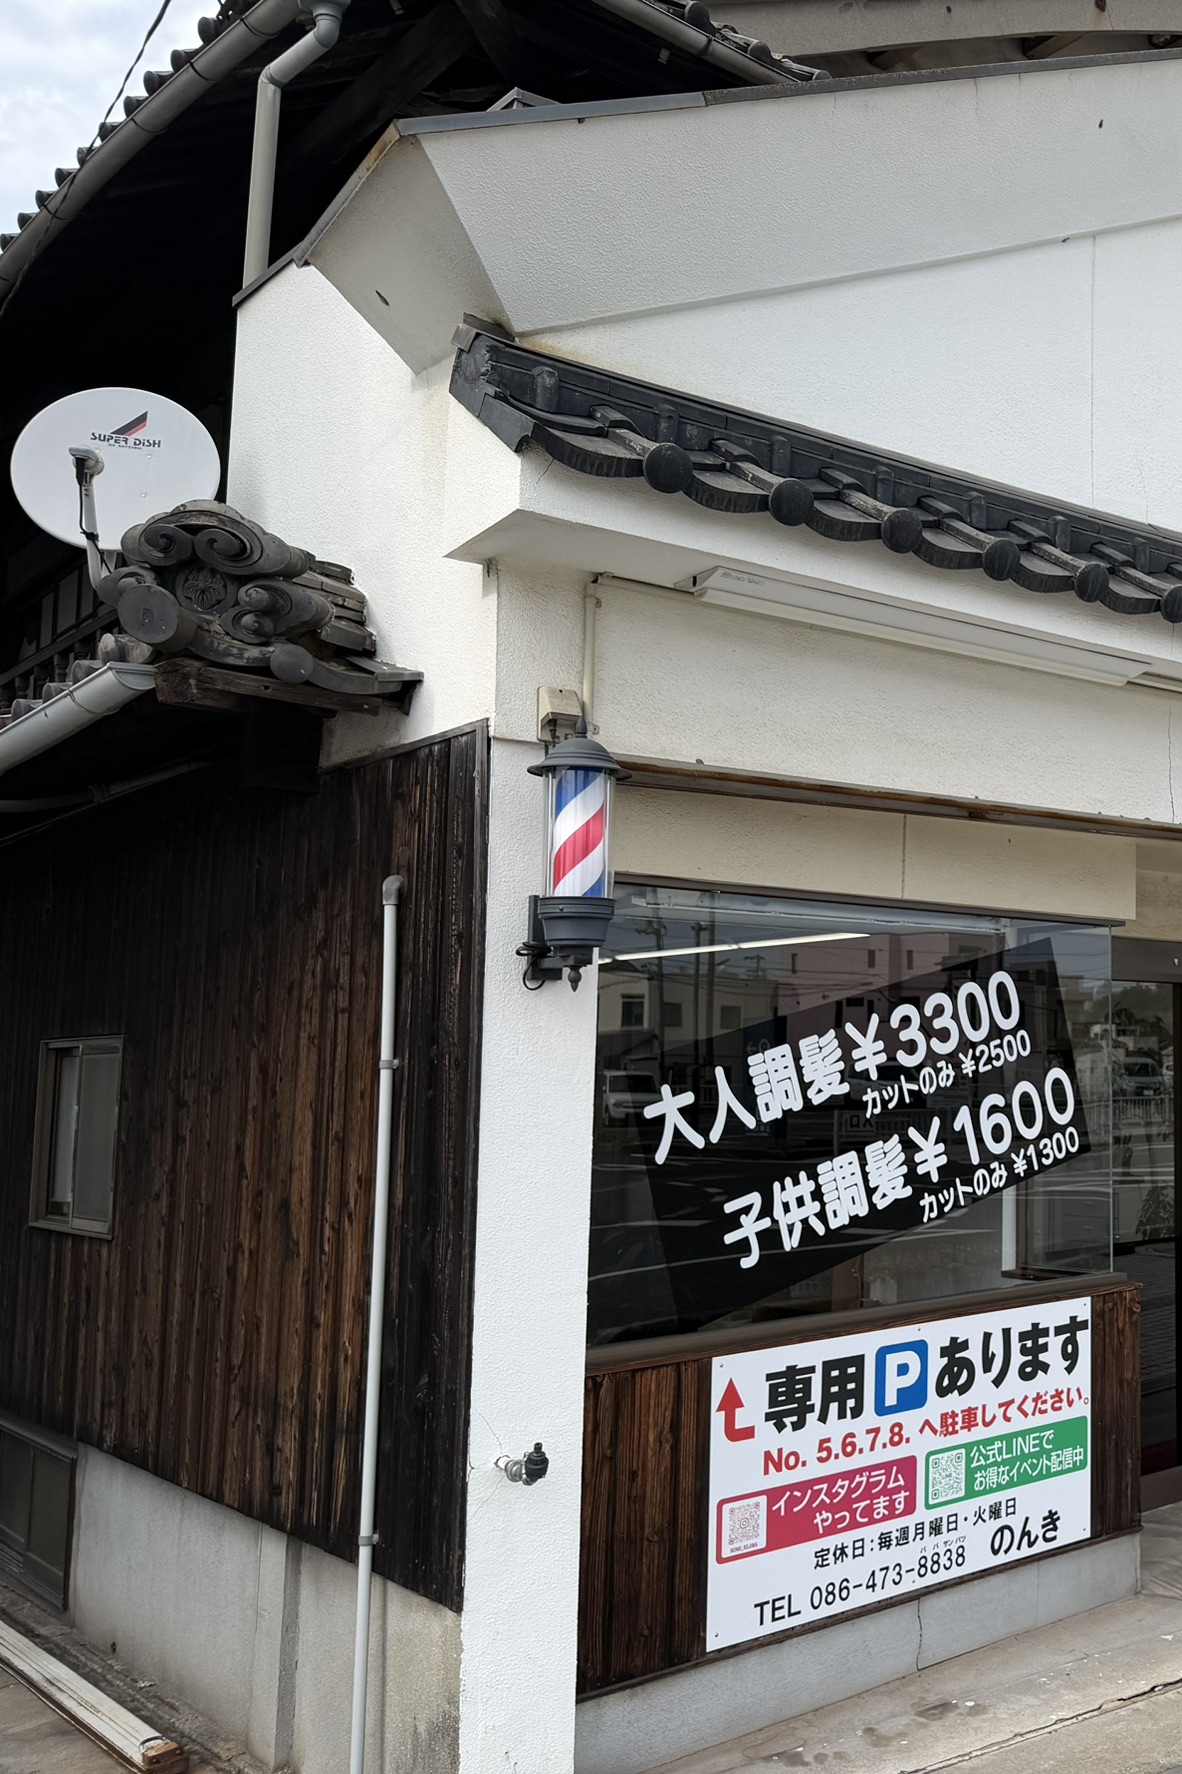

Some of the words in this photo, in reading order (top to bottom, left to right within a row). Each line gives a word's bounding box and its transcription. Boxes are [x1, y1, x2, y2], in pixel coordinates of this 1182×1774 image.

[90, 432, 129, 445] SUPER
[862, 1060, 955, 1119] カットのみ
[960, 1029, 1031, 1078] ¥2500
[919, 1161, 1008, 1223] カットのみ
[1011, 1127, 1079, 1178] ¥1300
[764, 1353, 865, 1434] 専用
[935, 1315, 1089, 1398] あります
[763, 1447, 808, 1476] No.
[816, 1421, 911, 1465] 5.6.7.8.
[919, 1385, 1089, 1439] へ駐車してください。
[970, 1430, 1054, 1469] 公式LINEで
[772, 1465, 906, 1517] インスタグラム
[974, 1444, 1084, 1492] お得なイベント配信中
[813, 1488, 910, 1535] やってます
[990, 1508, 1061, 1557] のんき
[754, 1593, 801, 1627] TEL
[810, 1544, 967, 1611] 086-473-8838
